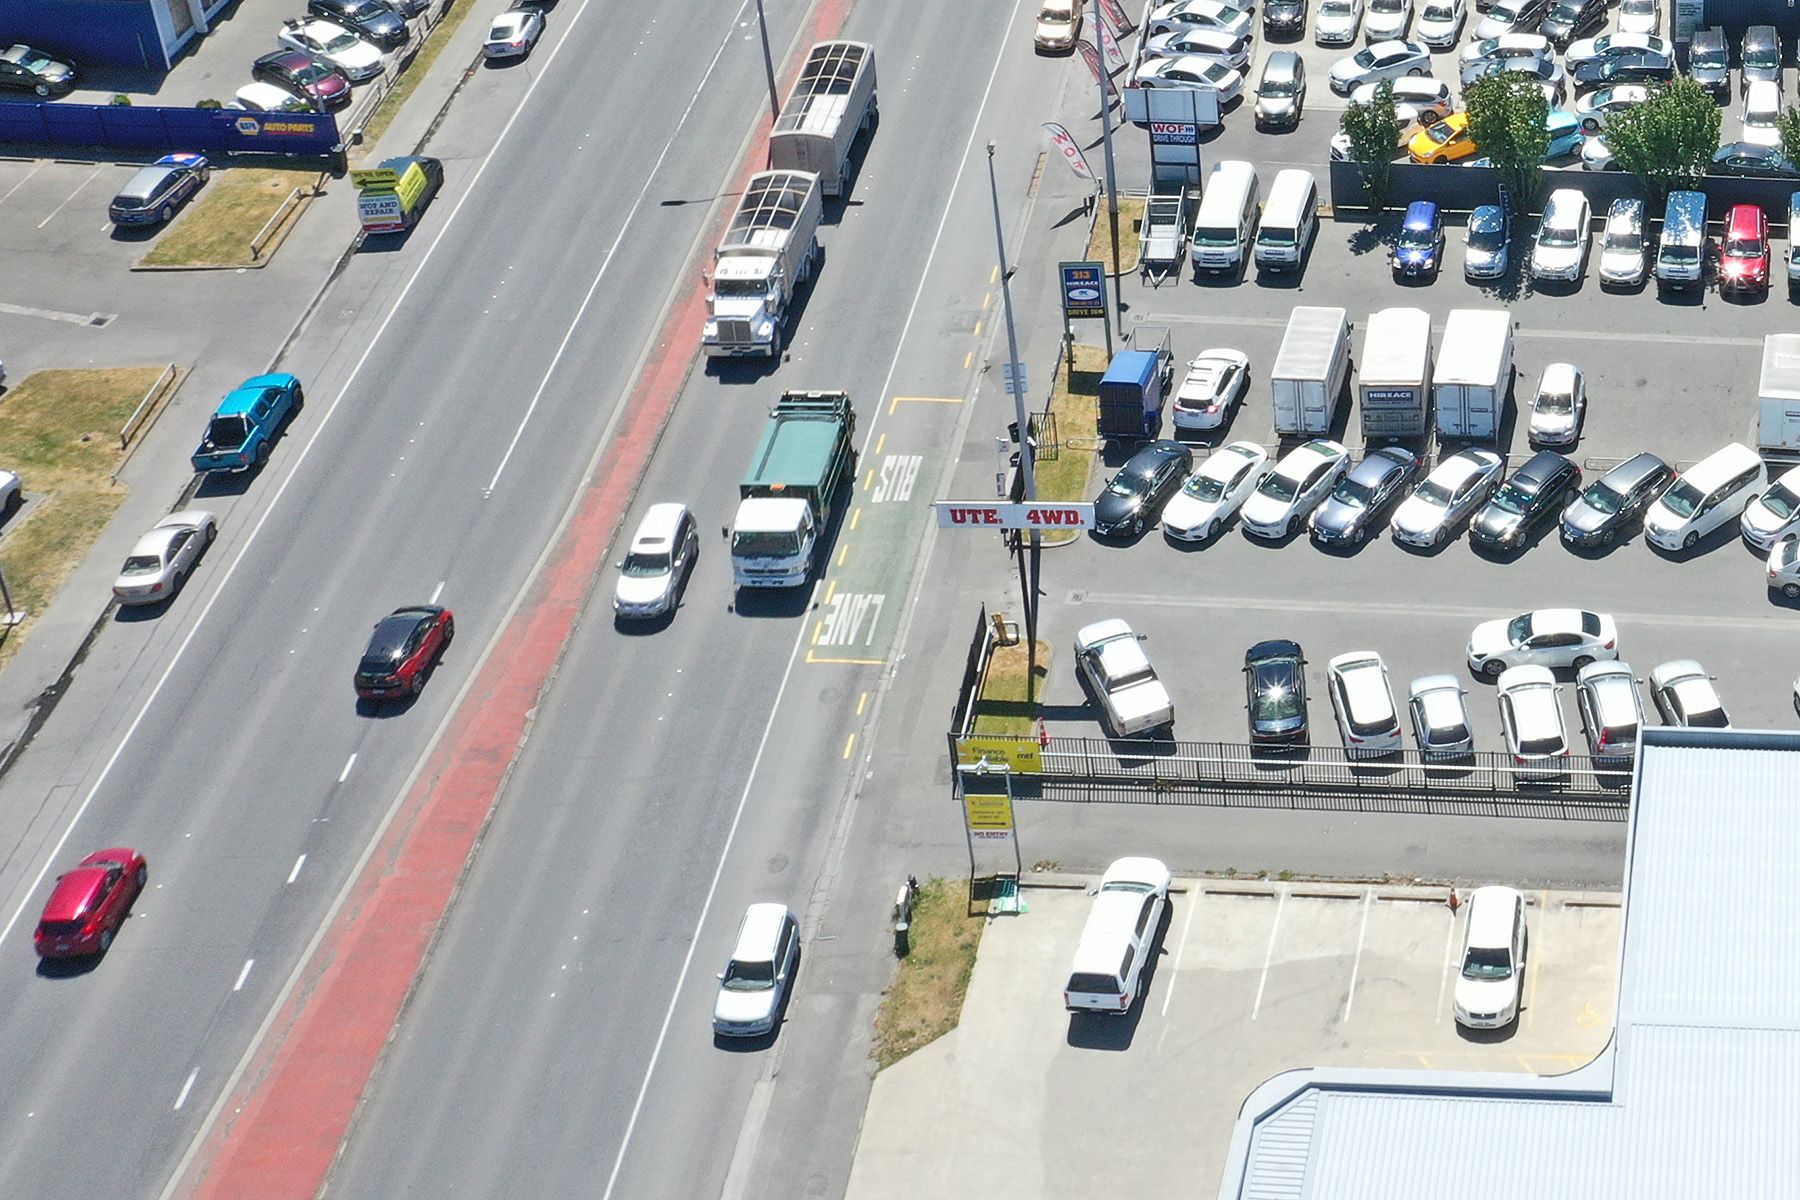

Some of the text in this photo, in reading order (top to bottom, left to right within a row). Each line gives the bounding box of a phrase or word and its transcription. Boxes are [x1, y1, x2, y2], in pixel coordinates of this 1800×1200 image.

[264, 122, 287, 132] AUTO
[288, 123, 315, 133] PARTS
[1152, 124, 1184, 133] WOF
[1153, 135, 1195, 143] DRIVE THROUGH
[1052, 132, 1085, 170] WOF
[871, 455, 923, 503] BUS
[949, 508, 1085, 525] UTE. 4WD.
[817, 592, 886, 645] LANE
